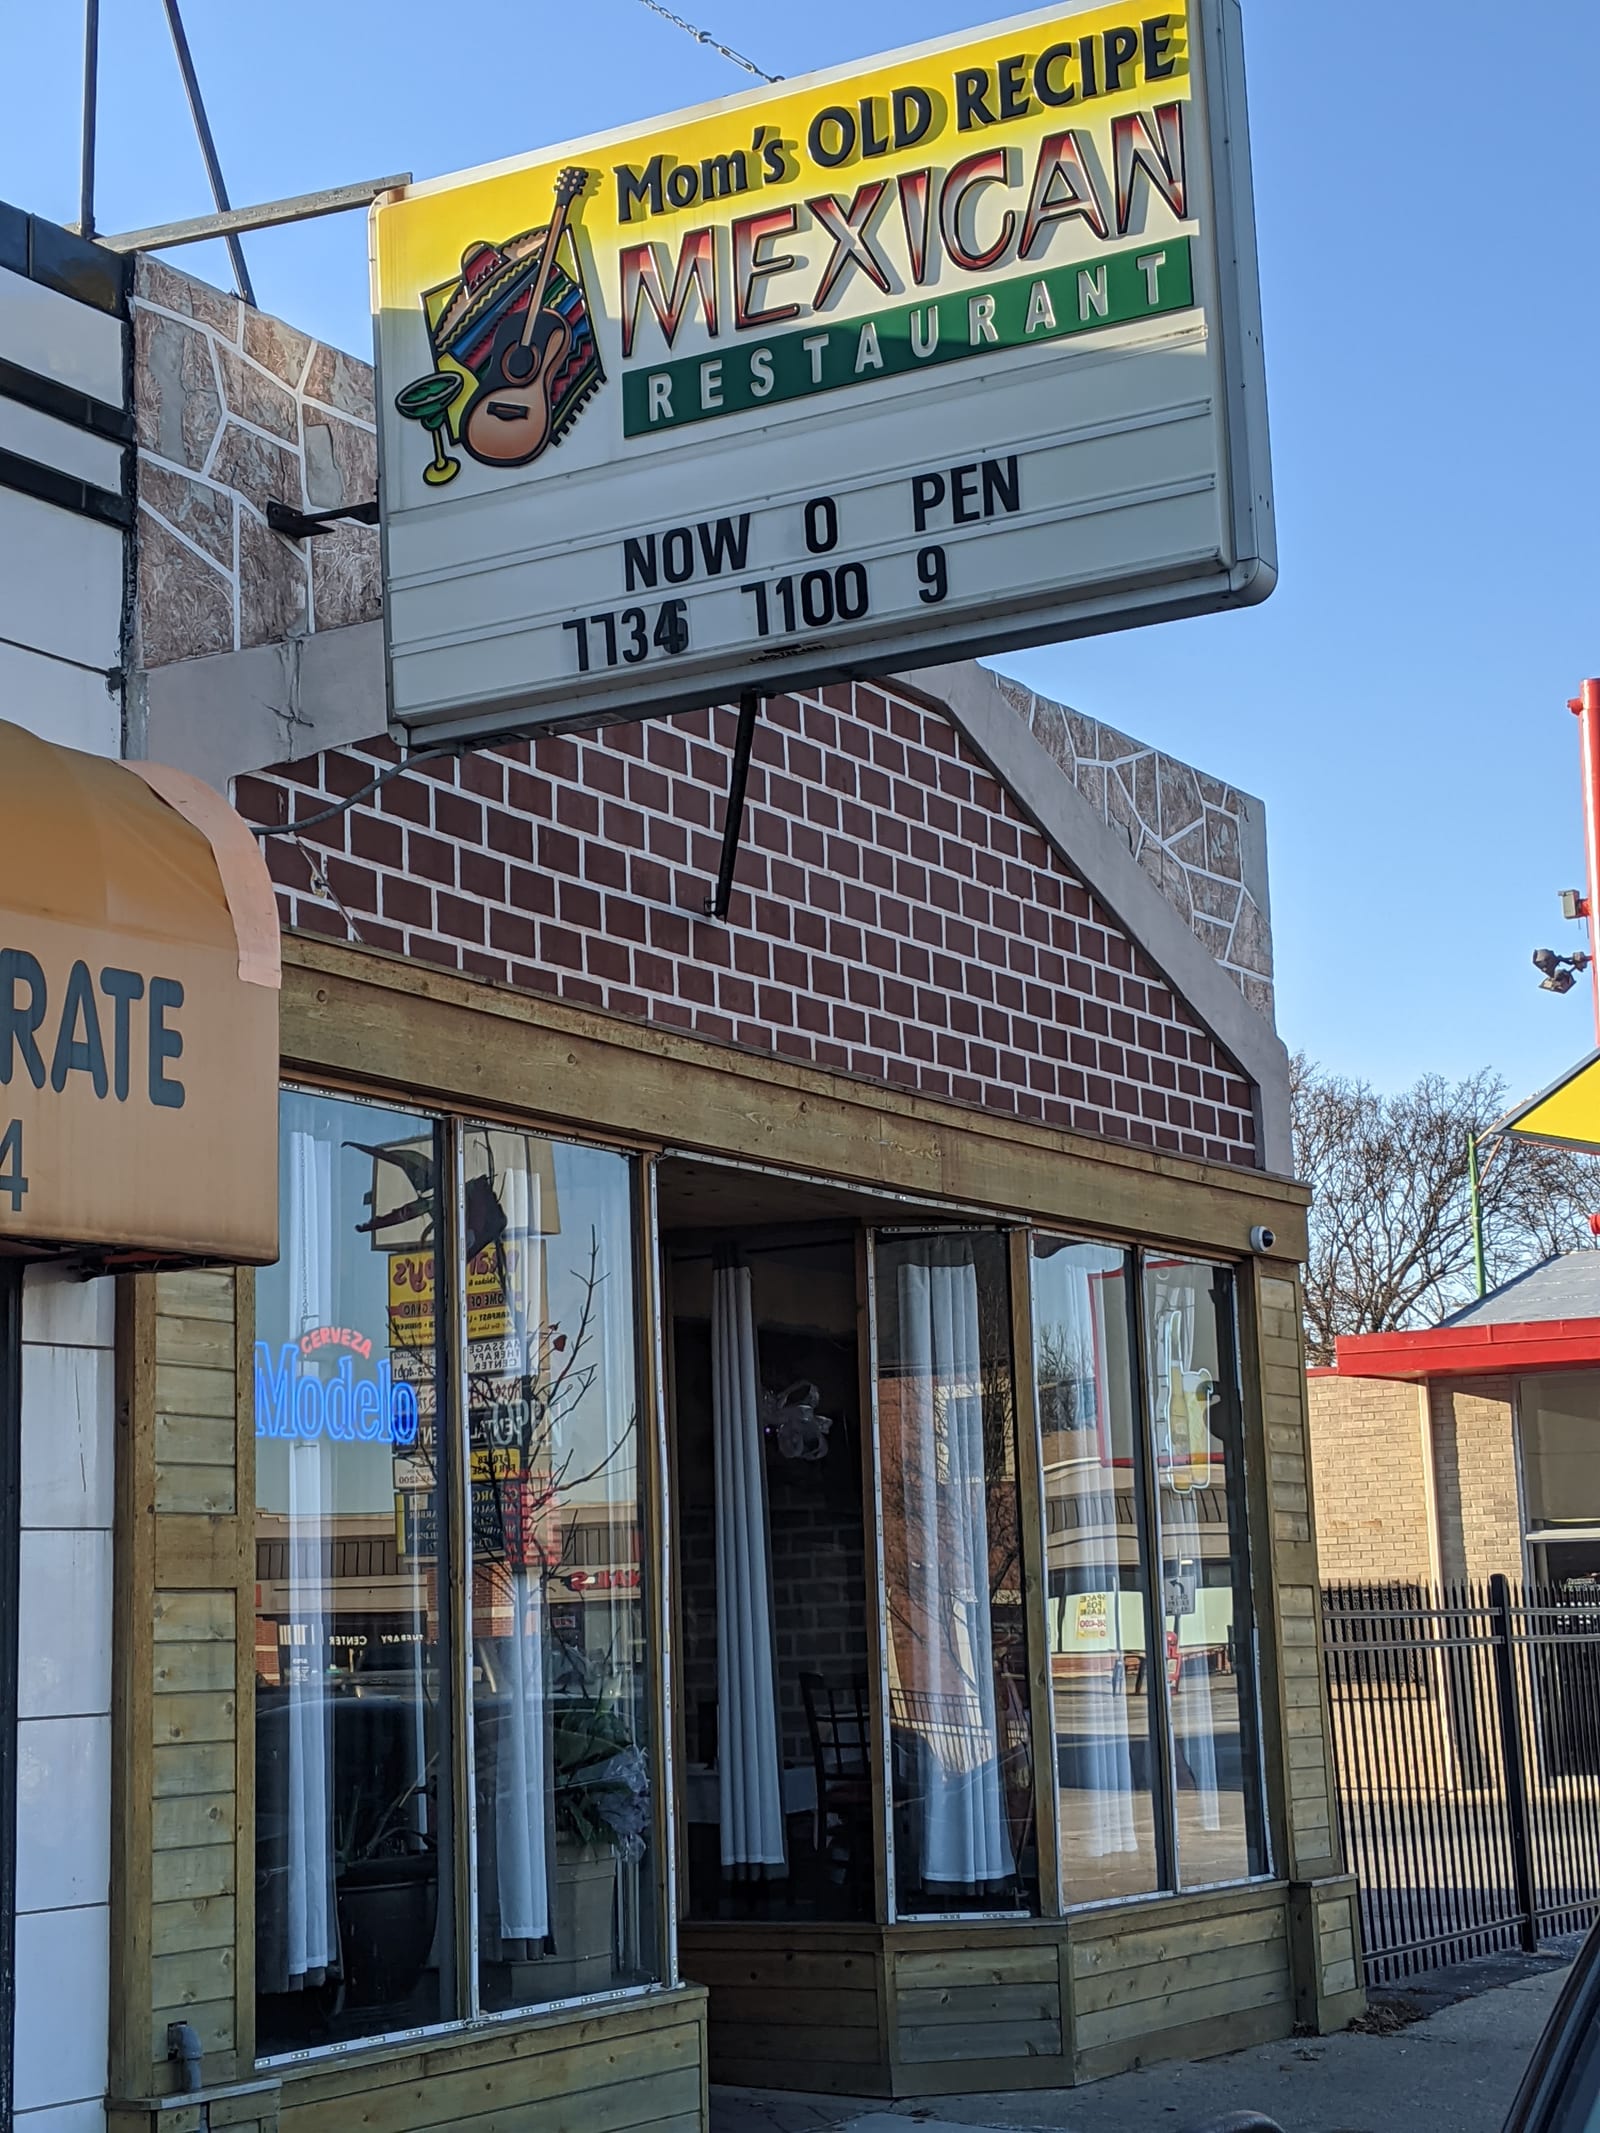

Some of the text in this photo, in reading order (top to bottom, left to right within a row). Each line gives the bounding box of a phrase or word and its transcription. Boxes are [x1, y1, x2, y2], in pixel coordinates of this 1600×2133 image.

[613, 14, 1184, 223] Mom's OLD RECIPE
[618, 101, 1188, 358] MEXICAN
[646, 249, 1168, 422] RESTAURANT
[623, 511, 752, 592] NOW
[910, 455, 1021, 532] PEN
[740, 562, 869, 637] 7100
[917, 546, 948, 604] 9
[255, 1340, 419, 1444] Modelo
[300, 1326, 373, 1360] CERVEZA
